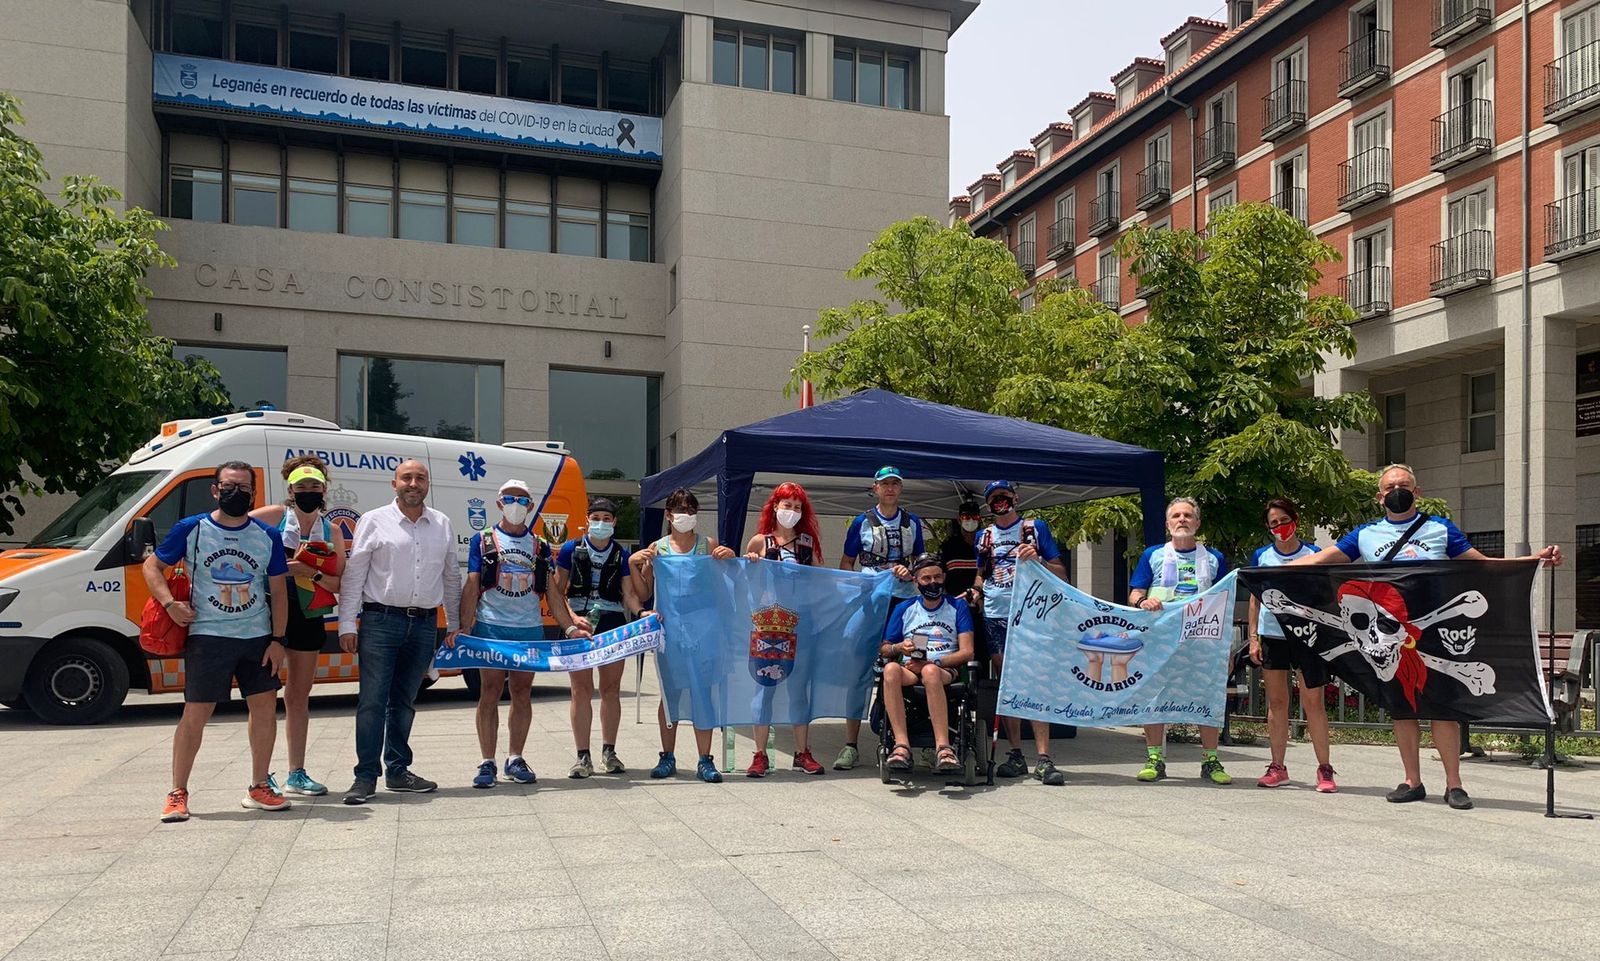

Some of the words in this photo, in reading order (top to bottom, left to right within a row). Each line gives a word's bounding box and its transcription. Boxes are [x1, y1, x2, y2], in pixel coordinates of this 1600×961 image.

[212, 73, 268, 94] Leganés
[273, 84, 287, 97] en
[290, 86, 347, 105] recuerdo
[350, 91, 367, 107] de
[370, 94, 405, 112] todas
[407, 98, 424, 115] las
[427, 101, 477, 121] víctimas
[479, 108, 496, 123] del
[499, 111, 551, 130] COVID-19
[552, 120, 566, 131] en
[567, 119, 577, 134] la
[579, 121, 615, 137] ciudad
[194, 263, 304, 294] CASA
[343, 275, 628, 319] CONSISTORIAL
[1374, 539, 1431, 557] CORRORES
[203, 548, 259, 570] CORREDORES
[86, 581, 121, 592] A-02
[496, 585, 534, 597] OLIDARIO
[207, 593, 258, 613] SOLIDARIOS
[1437, 625, 1478, 645] Rock
[1070, 665, 1144, 692] SOLIDARIOS
